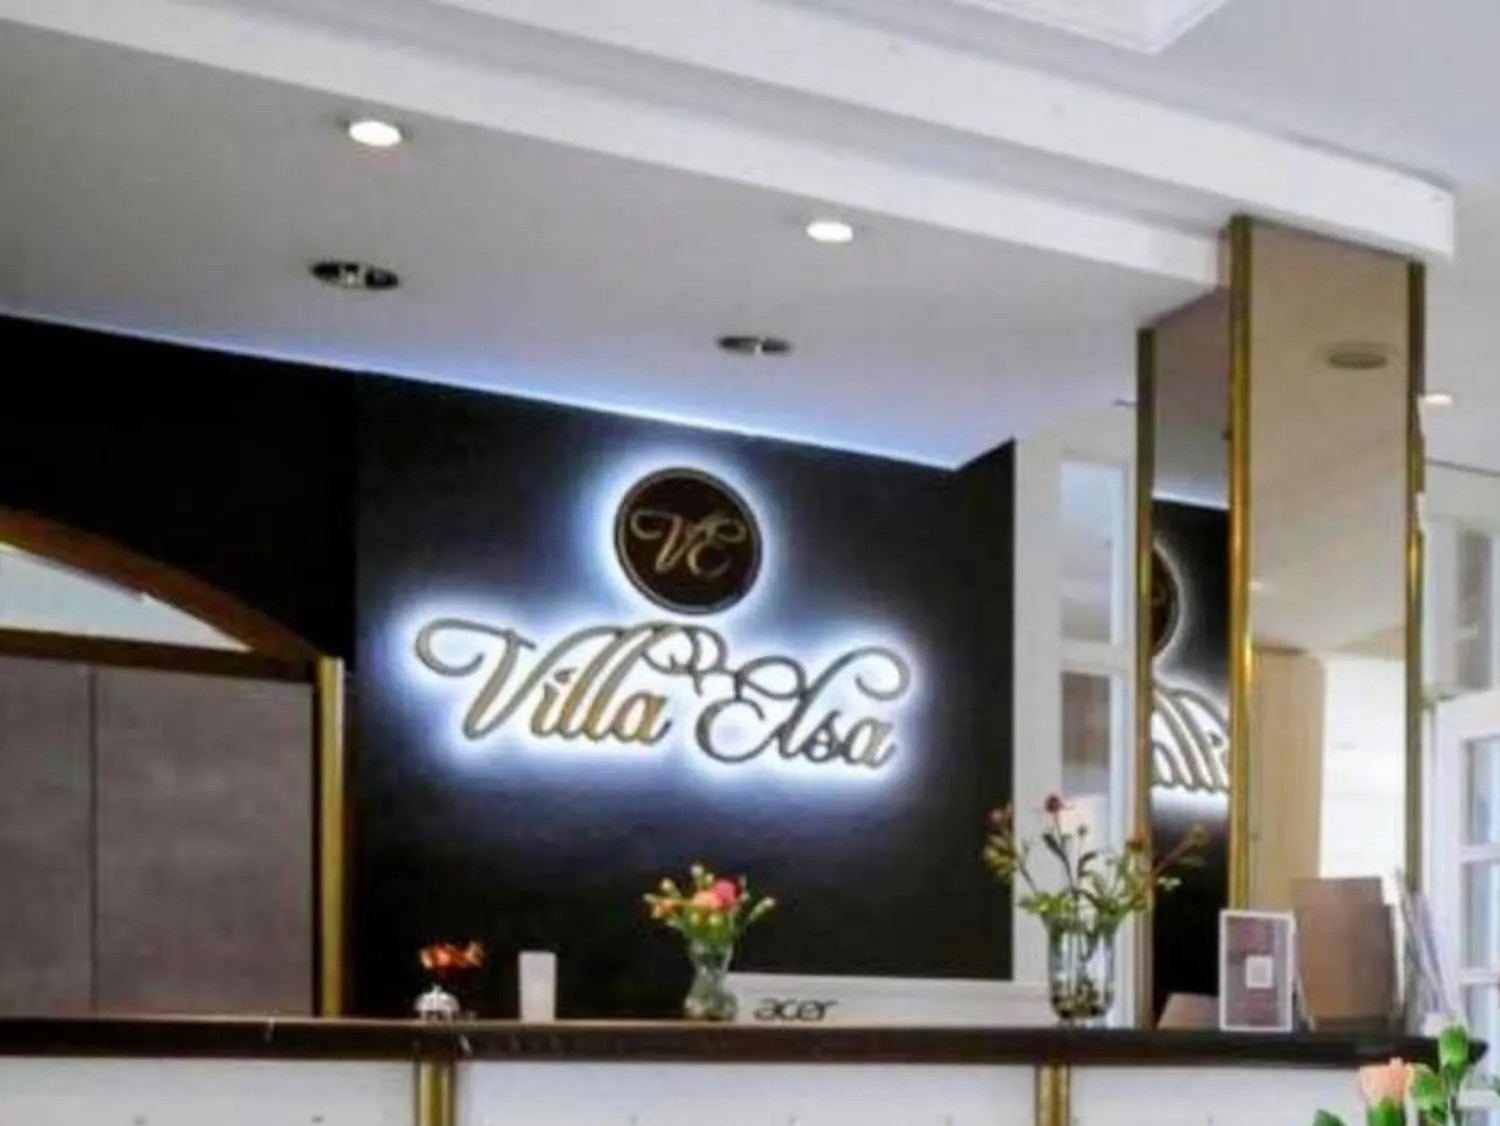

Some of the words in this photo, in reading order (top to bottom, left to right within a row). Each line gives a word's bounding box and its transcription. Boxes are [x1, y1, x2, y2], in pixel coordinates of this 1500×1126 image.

[414, 619, 694, 746] Villa
[694, 646, 911, 770] Elsa
[753, 997, 838, 1021] acer
